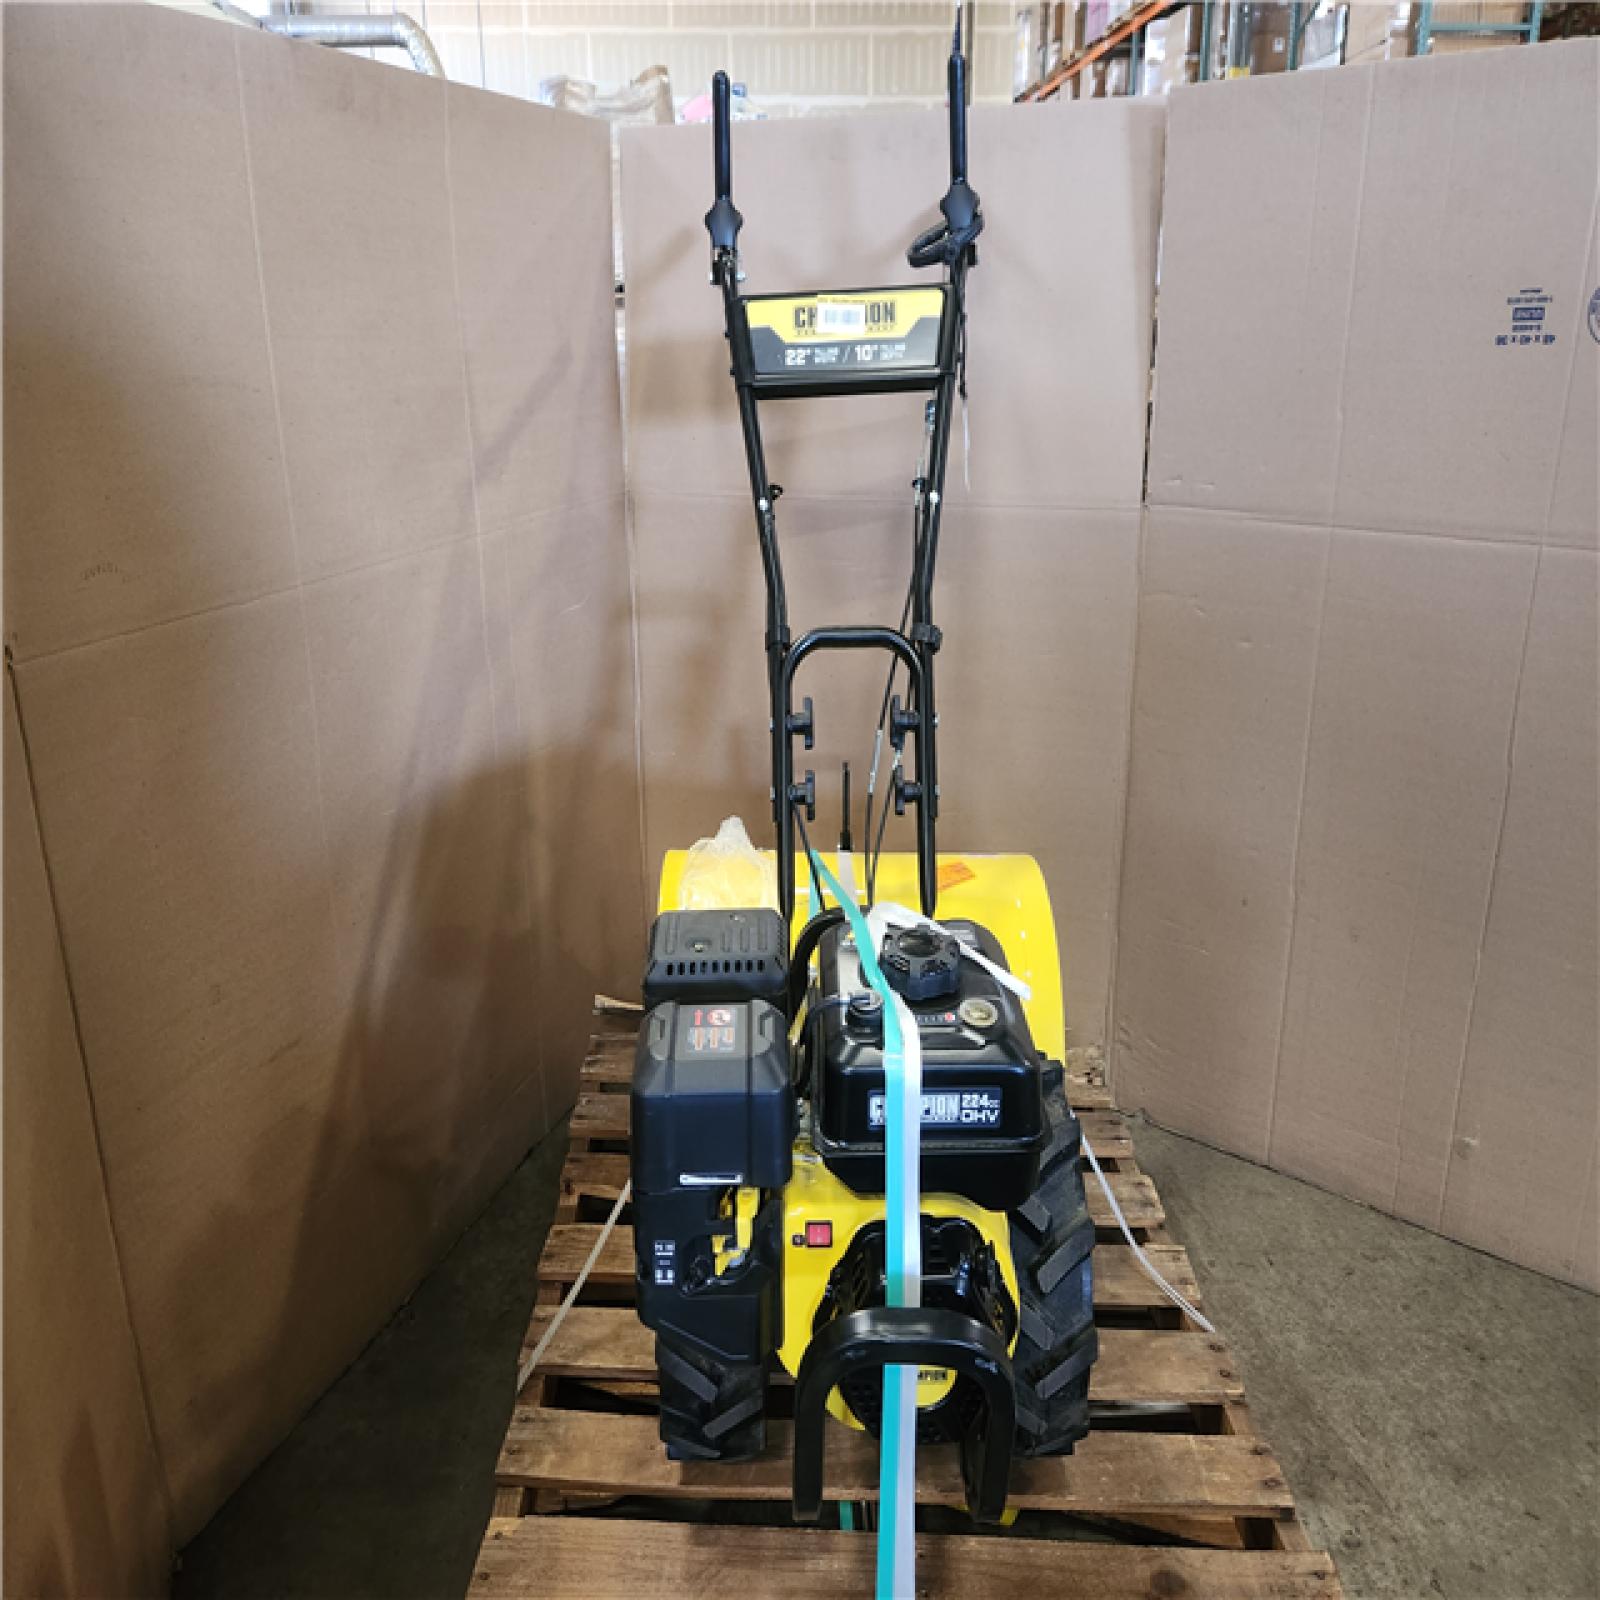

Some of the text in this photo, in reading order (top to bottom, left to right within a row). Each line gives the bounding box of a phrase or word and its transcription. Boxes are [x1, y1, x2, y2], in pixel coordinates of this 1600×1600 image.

[794, 301, 896, 329] CHION
[869, 1095, 960, 1120] CPION
[961, 1109, 1000, 1124] OHV
